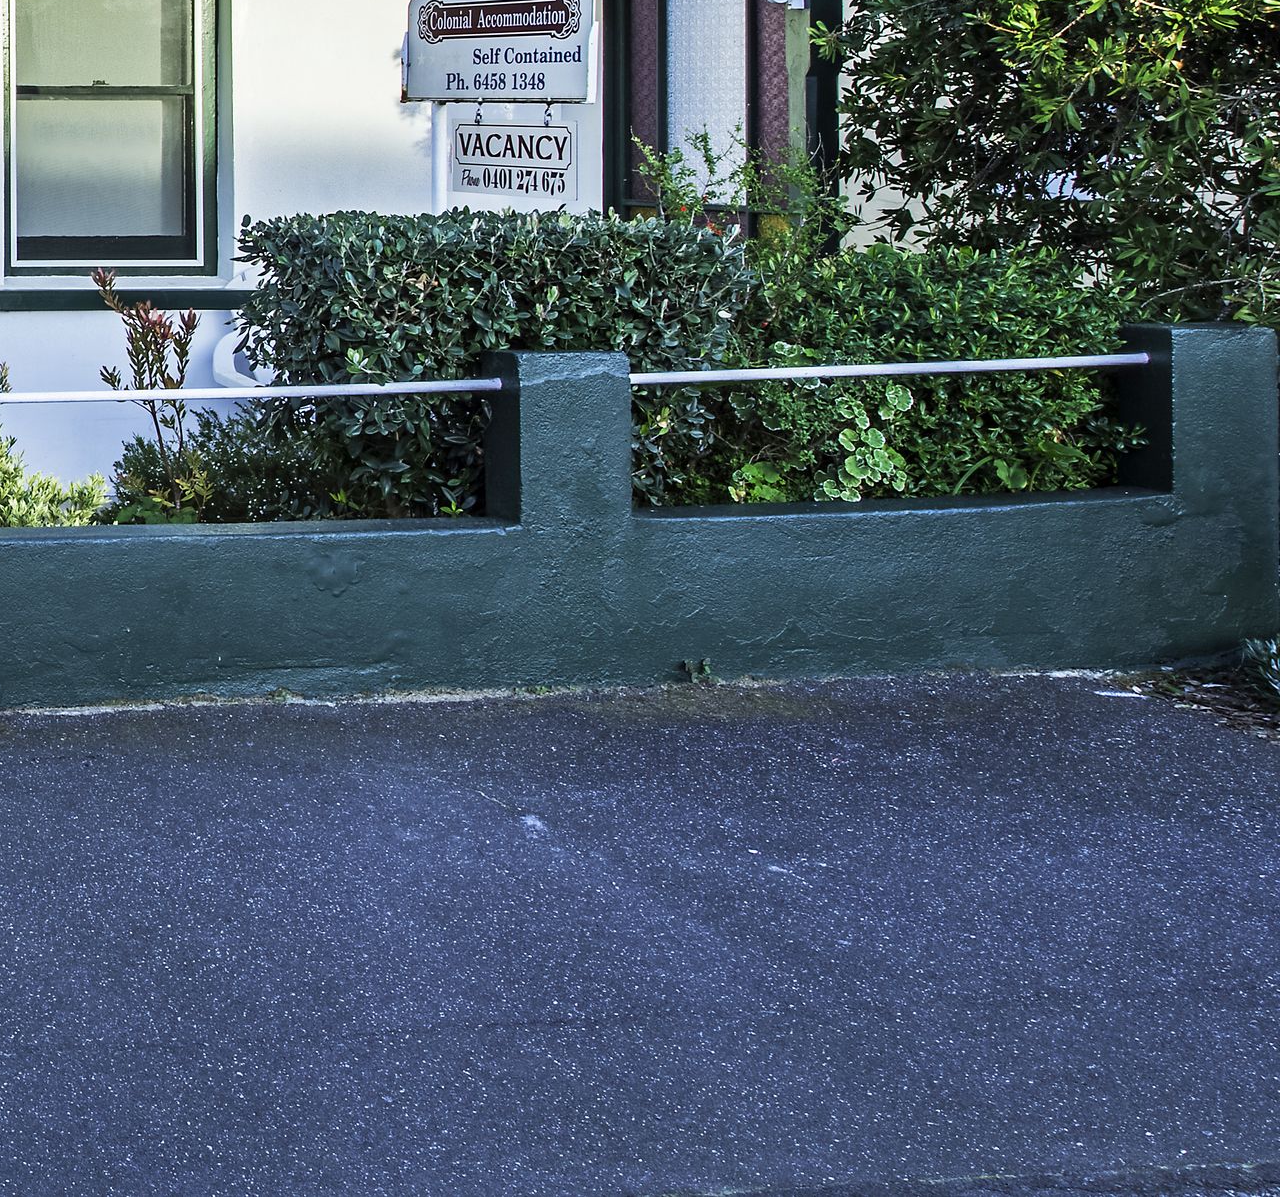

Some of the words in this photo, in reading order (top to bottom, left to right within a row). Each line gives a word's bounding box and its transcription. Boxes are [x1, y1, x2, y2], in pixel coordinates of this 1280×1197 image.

[430, 10, 472, 31] Colonial
[477, 5, 566, 29] Accommodation
[472, 47, 500, 65] Self
[504, 45, 582, 64] Contained
[445, 73, 469, 91] Ph.
[473, 73, 506, 91] 6458
[511, 72, 546, 91] 1348
[458, 133, 568, 161] VACANCY
[483, 167, 513, 190] 0401
[516, 169, 538, 194] 274
[541, 170, 566, 196] 675
